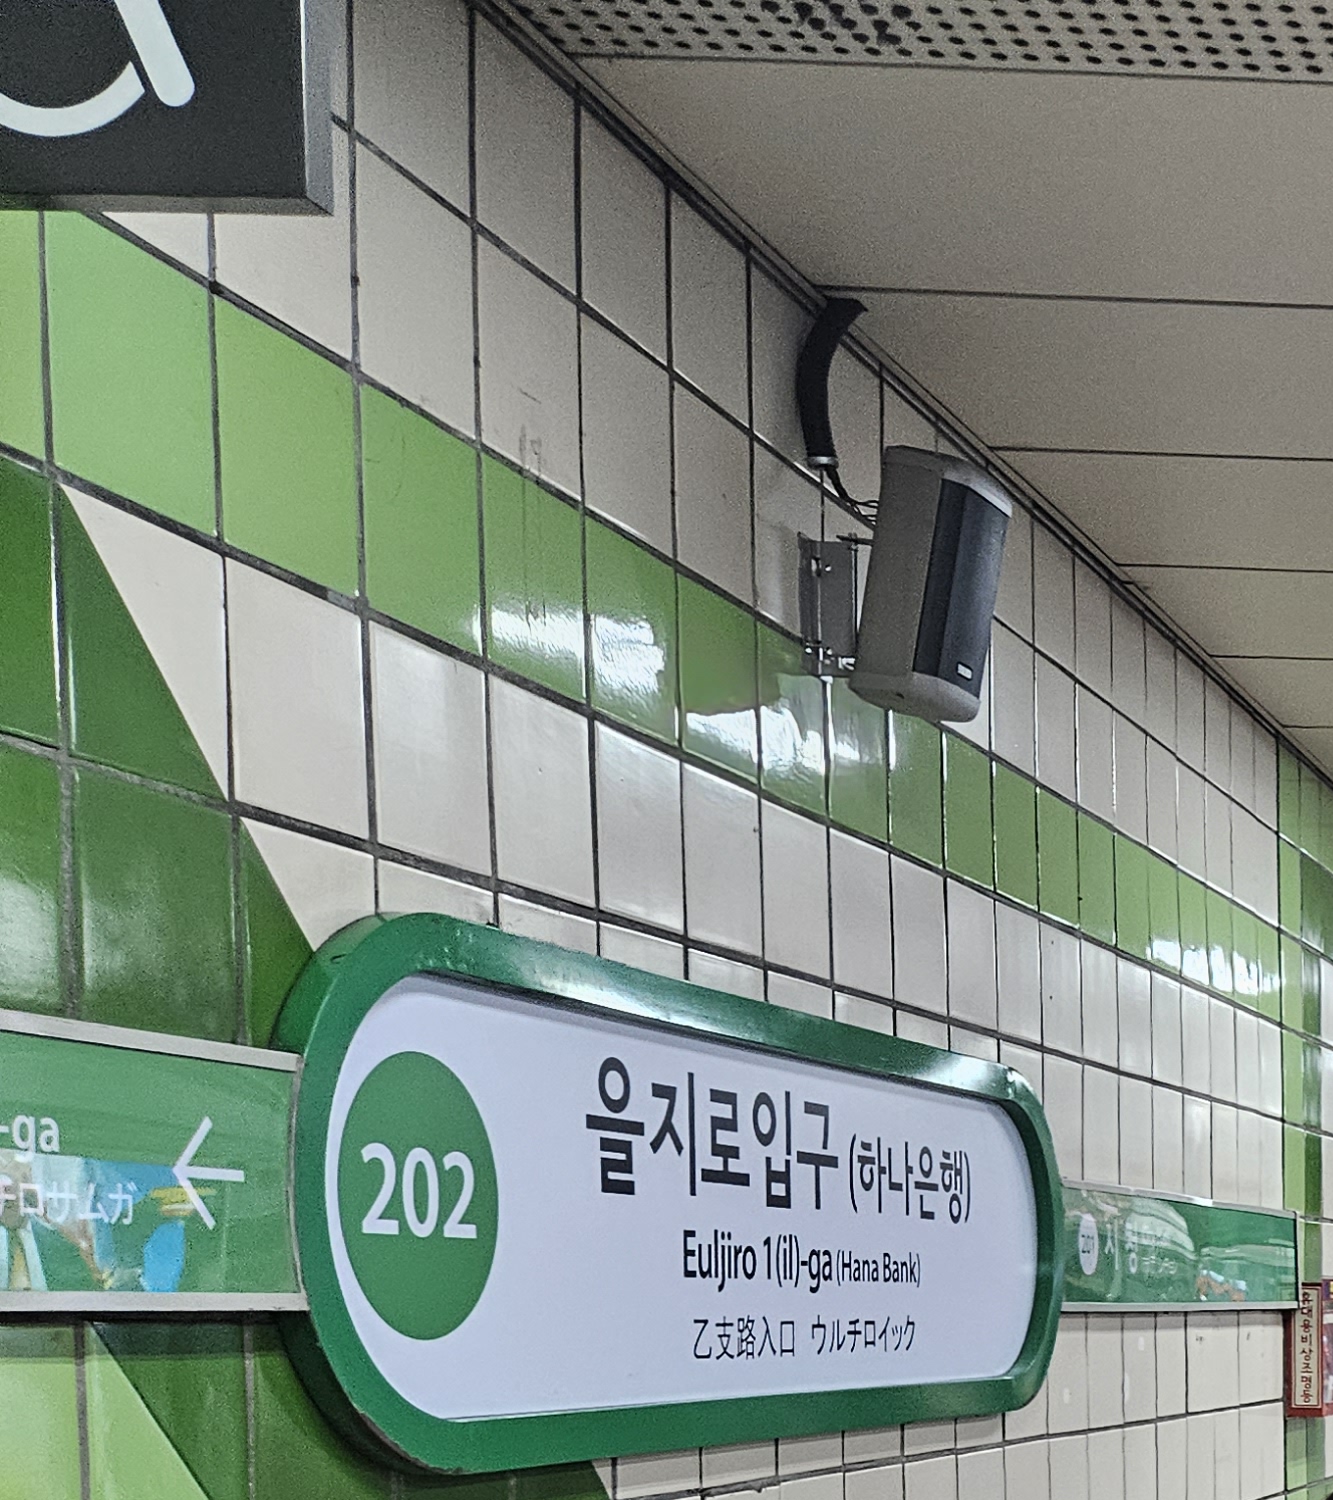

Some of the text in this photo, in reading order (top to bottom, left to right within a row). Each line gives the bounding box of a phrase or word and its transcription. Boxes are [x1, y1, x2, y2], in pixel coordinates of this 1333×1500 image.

[586, 1056, 972, 1225] 을지로입구 (하나은행)
[361, 1142, 478, 1239] 202
[683, 1229, 921, 1294] Euljiro 1(il)-ga (Hana Bank)
[693, 1314, 917, 1361] 乙支路入口 ウルチロイック
